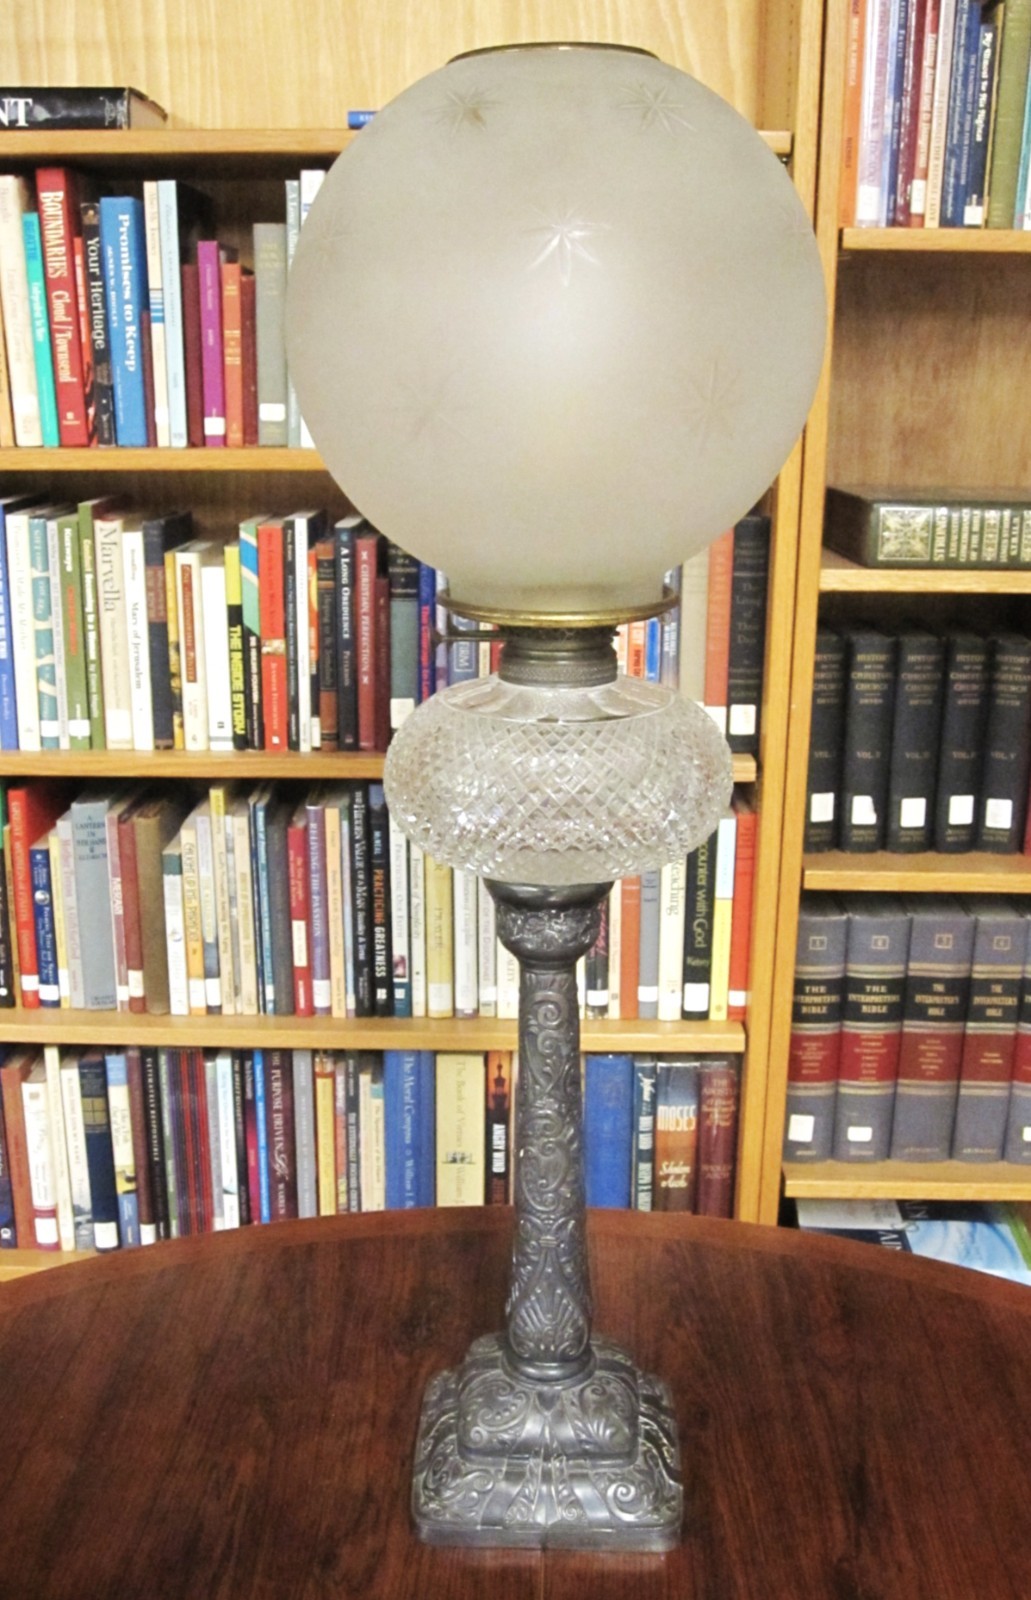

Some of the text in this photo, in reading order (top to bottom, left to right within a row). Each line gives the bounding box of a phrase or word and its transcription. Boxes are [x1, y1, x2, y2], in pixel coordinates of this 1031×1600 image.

[39, 191, 67, 278] BOUNDARIES
[87, 237, 101, 276] Your
[52, 290, 73, 322] Cloud
[118, 214, 137, 372] Promises to Keep
[91, 281, 106, 350] Heritage
[55, 332, 78, 383] Townsend
[64, 528, 74, 572] Kuzwayo
[340, 547, 350, 555] A
[99, 527, 125, 613] Marvella
[341, 558, 351, 584] LONG
[84, 574, 94, 612] Becoming
[87, 615, 94, 623] to
[341, 587, 352, 640] OBEDIENCE
[360, 564, 371, 672] CHRISTIAN PERFECTION
[421, 605, 430, 624] The
[88, 632, 97, 660] Woman
[421, 626, 430, 667] Courage
[132, 642, 144, 689] Jerusalem
[229, 625, 246, 735] THE INSIDE STORY
[11, 802, 24, 836] GREAT
[12, 841, 25, 878] WOMEN
[395, 844, 403, 892] PRACTICING
[310, 823, 322, 937] RELIVING THE PASSION
[373, 869, 386, 977] PRACTICING GREATNESS
[693, 891, 709, 949] with God
[805, 985, 827, 993] THE
[865, 985, 888, 993] THE
[802, 1005, 828, 1014] BIBLE
[861, 1005, 888, 1014] BIBLE
[403, 1056, 414, 1073] The
[271, 1069, 282, 1111] PURPOSE
[404, 1076, 415, 1101] Moral
[455, 1081, 466, 1101] Book
[146, 1058, 159, 1161] ULTIMATELY RESPONSIBLE
[347, 1112, 356, 1124] THE
[402, 1105, 415, 1144] Compass
[456, 1105, 466, 1114] of
[657, 1105, 696, 1132] MOSES
[272, 1113, 284, 1150] DRIVEN
[456, 1118, 466, 1147] Virtues
[491, 1123, 506, 1173] ANGRY WIND
[277, 1183, 286, 1215] WARREN
